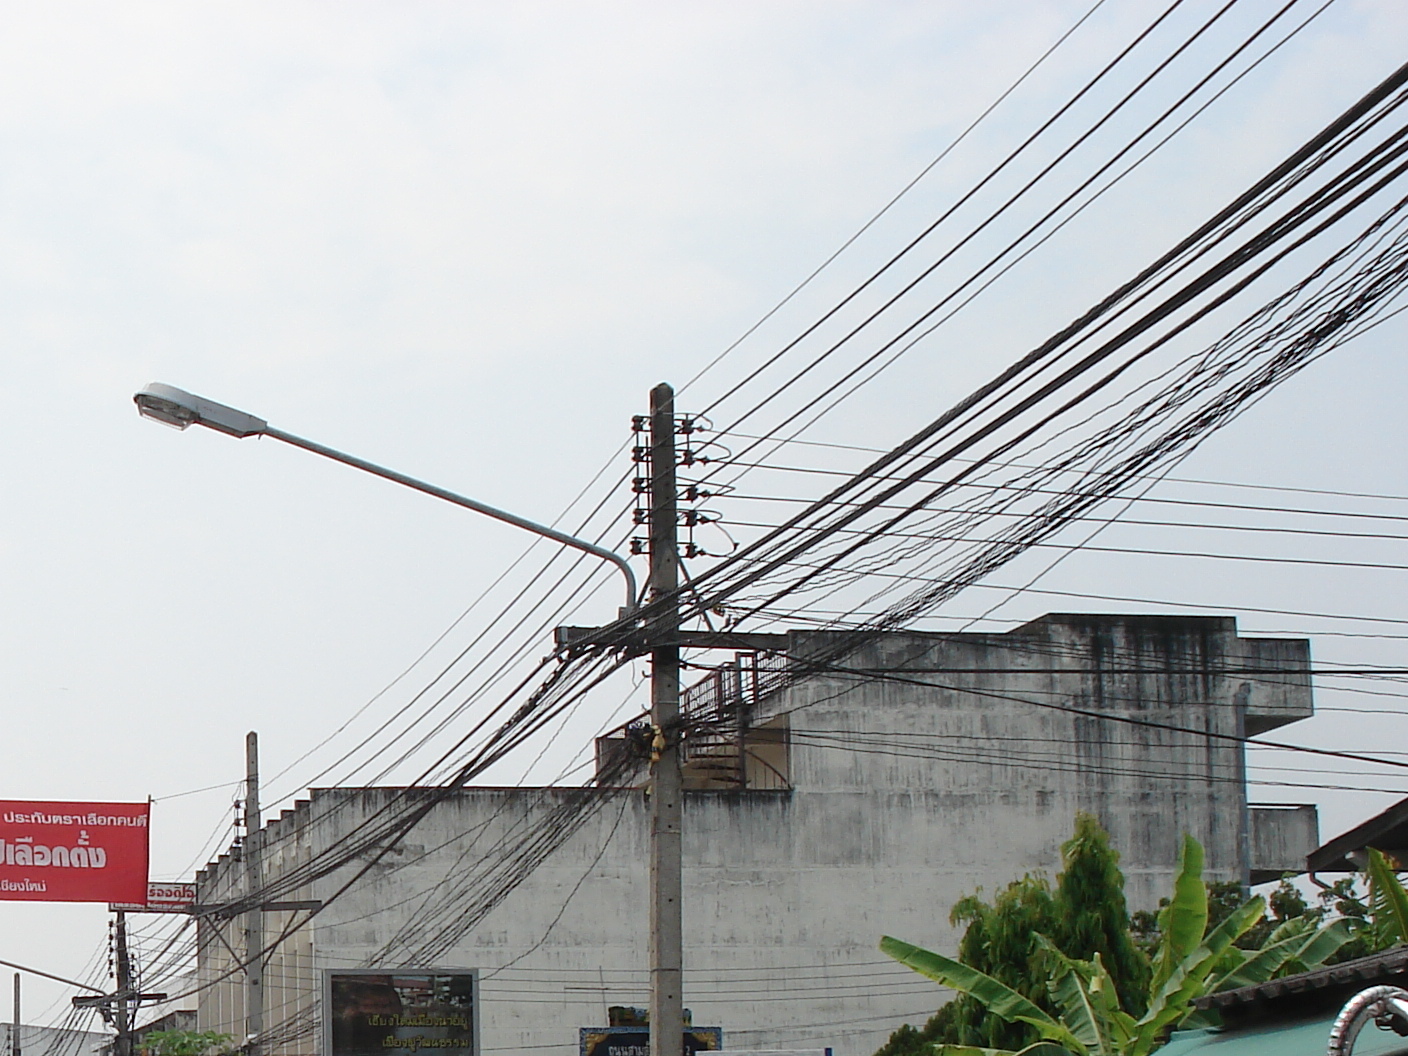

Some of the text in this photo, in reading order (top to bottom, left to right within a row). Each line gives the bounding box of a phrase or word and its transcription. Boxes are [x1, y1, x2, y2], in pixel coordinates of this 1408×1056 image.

[3, 810, 148, 828] ประทับตราเลือกคนดี
